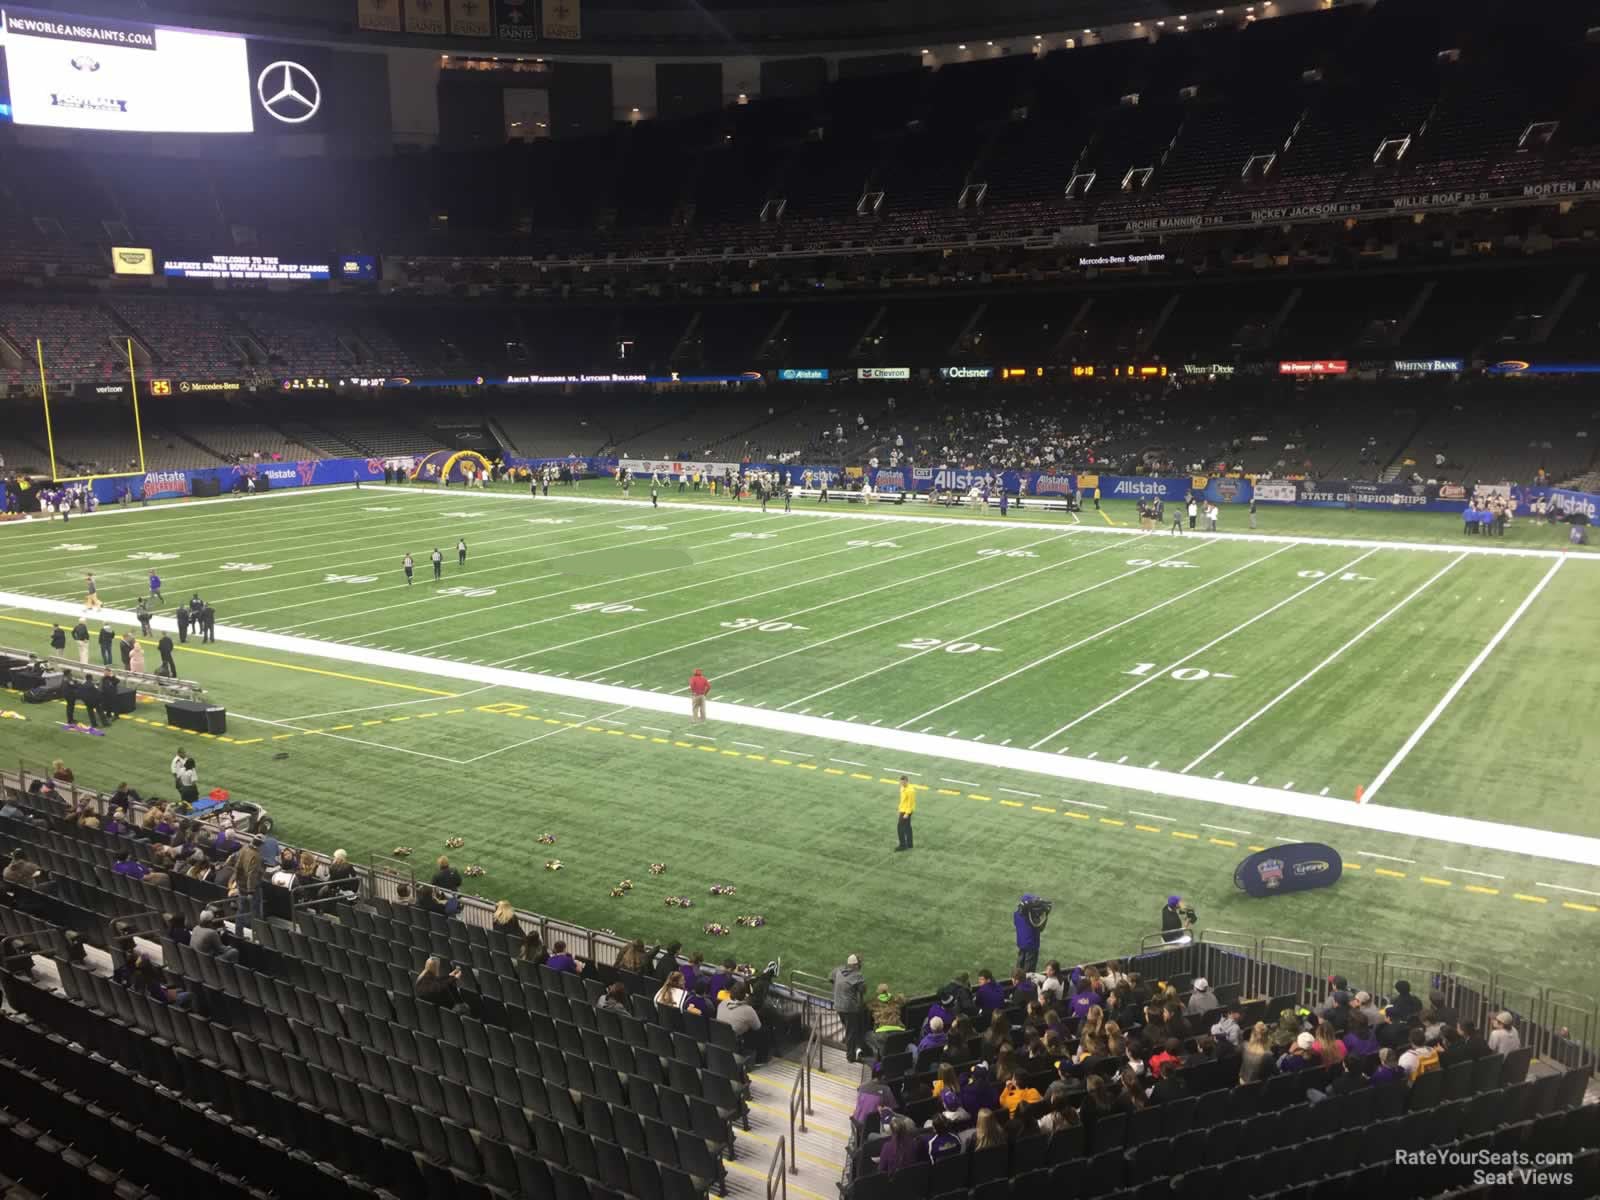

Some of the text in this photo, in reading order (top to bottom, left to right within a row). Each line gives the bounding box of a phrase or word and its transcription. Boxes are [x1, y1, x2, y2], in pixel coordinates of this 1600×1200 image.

[8, 17, 153, 45] NEWORLEANSSAINTS.COM
[1523, 182, 1576, 195] MORTEN
[1393, 194, 1430, 208] WILLIE
[1432, 192, 1463, 206] ROAF
[1251, 208, 1287, 220] RICKEY
[1289, 203, 1337, 217] JACKSON
[1125, 220, 1159, 232] ARCHIE
[1160, 215, 1202, 227] MANNING
[212, 255, 279, 265] WELCOME TO THE
[1079, 252, 1165, 265] Mercedes-Benz Superdome
[874, 369, 905, 378] Chevron
[949, 367, 989, 378] Ochsner
[1212, 364, 1235, 374] Dixie
[96, 386, 123, 394] verizon
[153, 381, 169, 393] 25
[191, 382, 240, 391] Mercedes-Benz
[144, 471, 185, 483] Allstate
[934, 470, 1004, 489] Allstate
[1114, 480, 1167, 495] Allstate
[1300, 492, 1334, 501] STATE
[1336, 492, 1427, 505] CHMPIONHIPS
[1545, 492, 1596, 519] Allstate
[719, 617, 793, 632] 30
[897, 637, 982, 654] 20
[1120, 662, 1210, 681] 10
